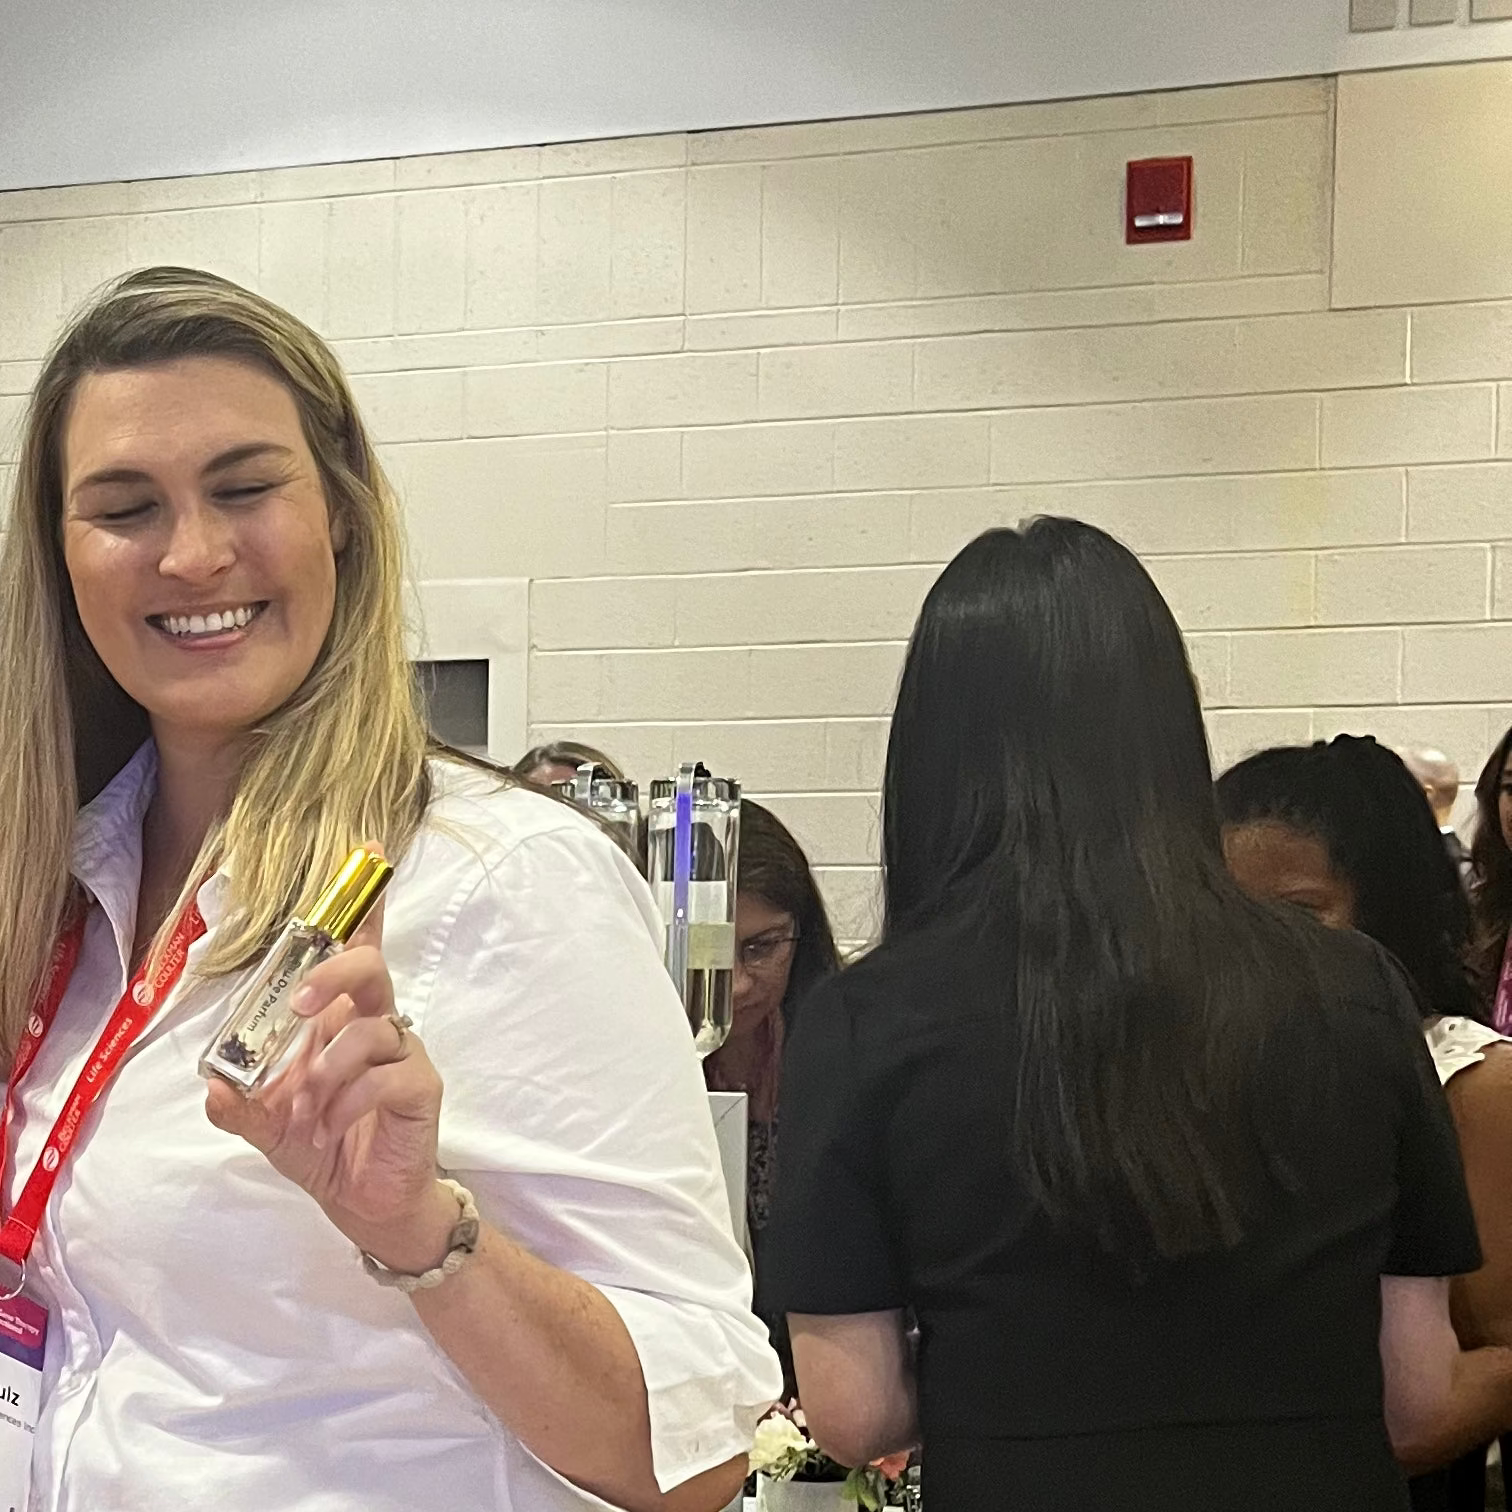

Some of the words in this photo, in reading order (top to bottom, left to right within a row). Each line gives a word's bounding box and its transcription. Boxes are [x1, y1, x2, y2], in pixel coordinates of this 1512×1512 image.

[272, 978, 288, 994] De
[247, 994, 278, 1032] Parfum
[86, 1060, 104, 1083] Life
[99, 1017, 133, 1062] Sciences
